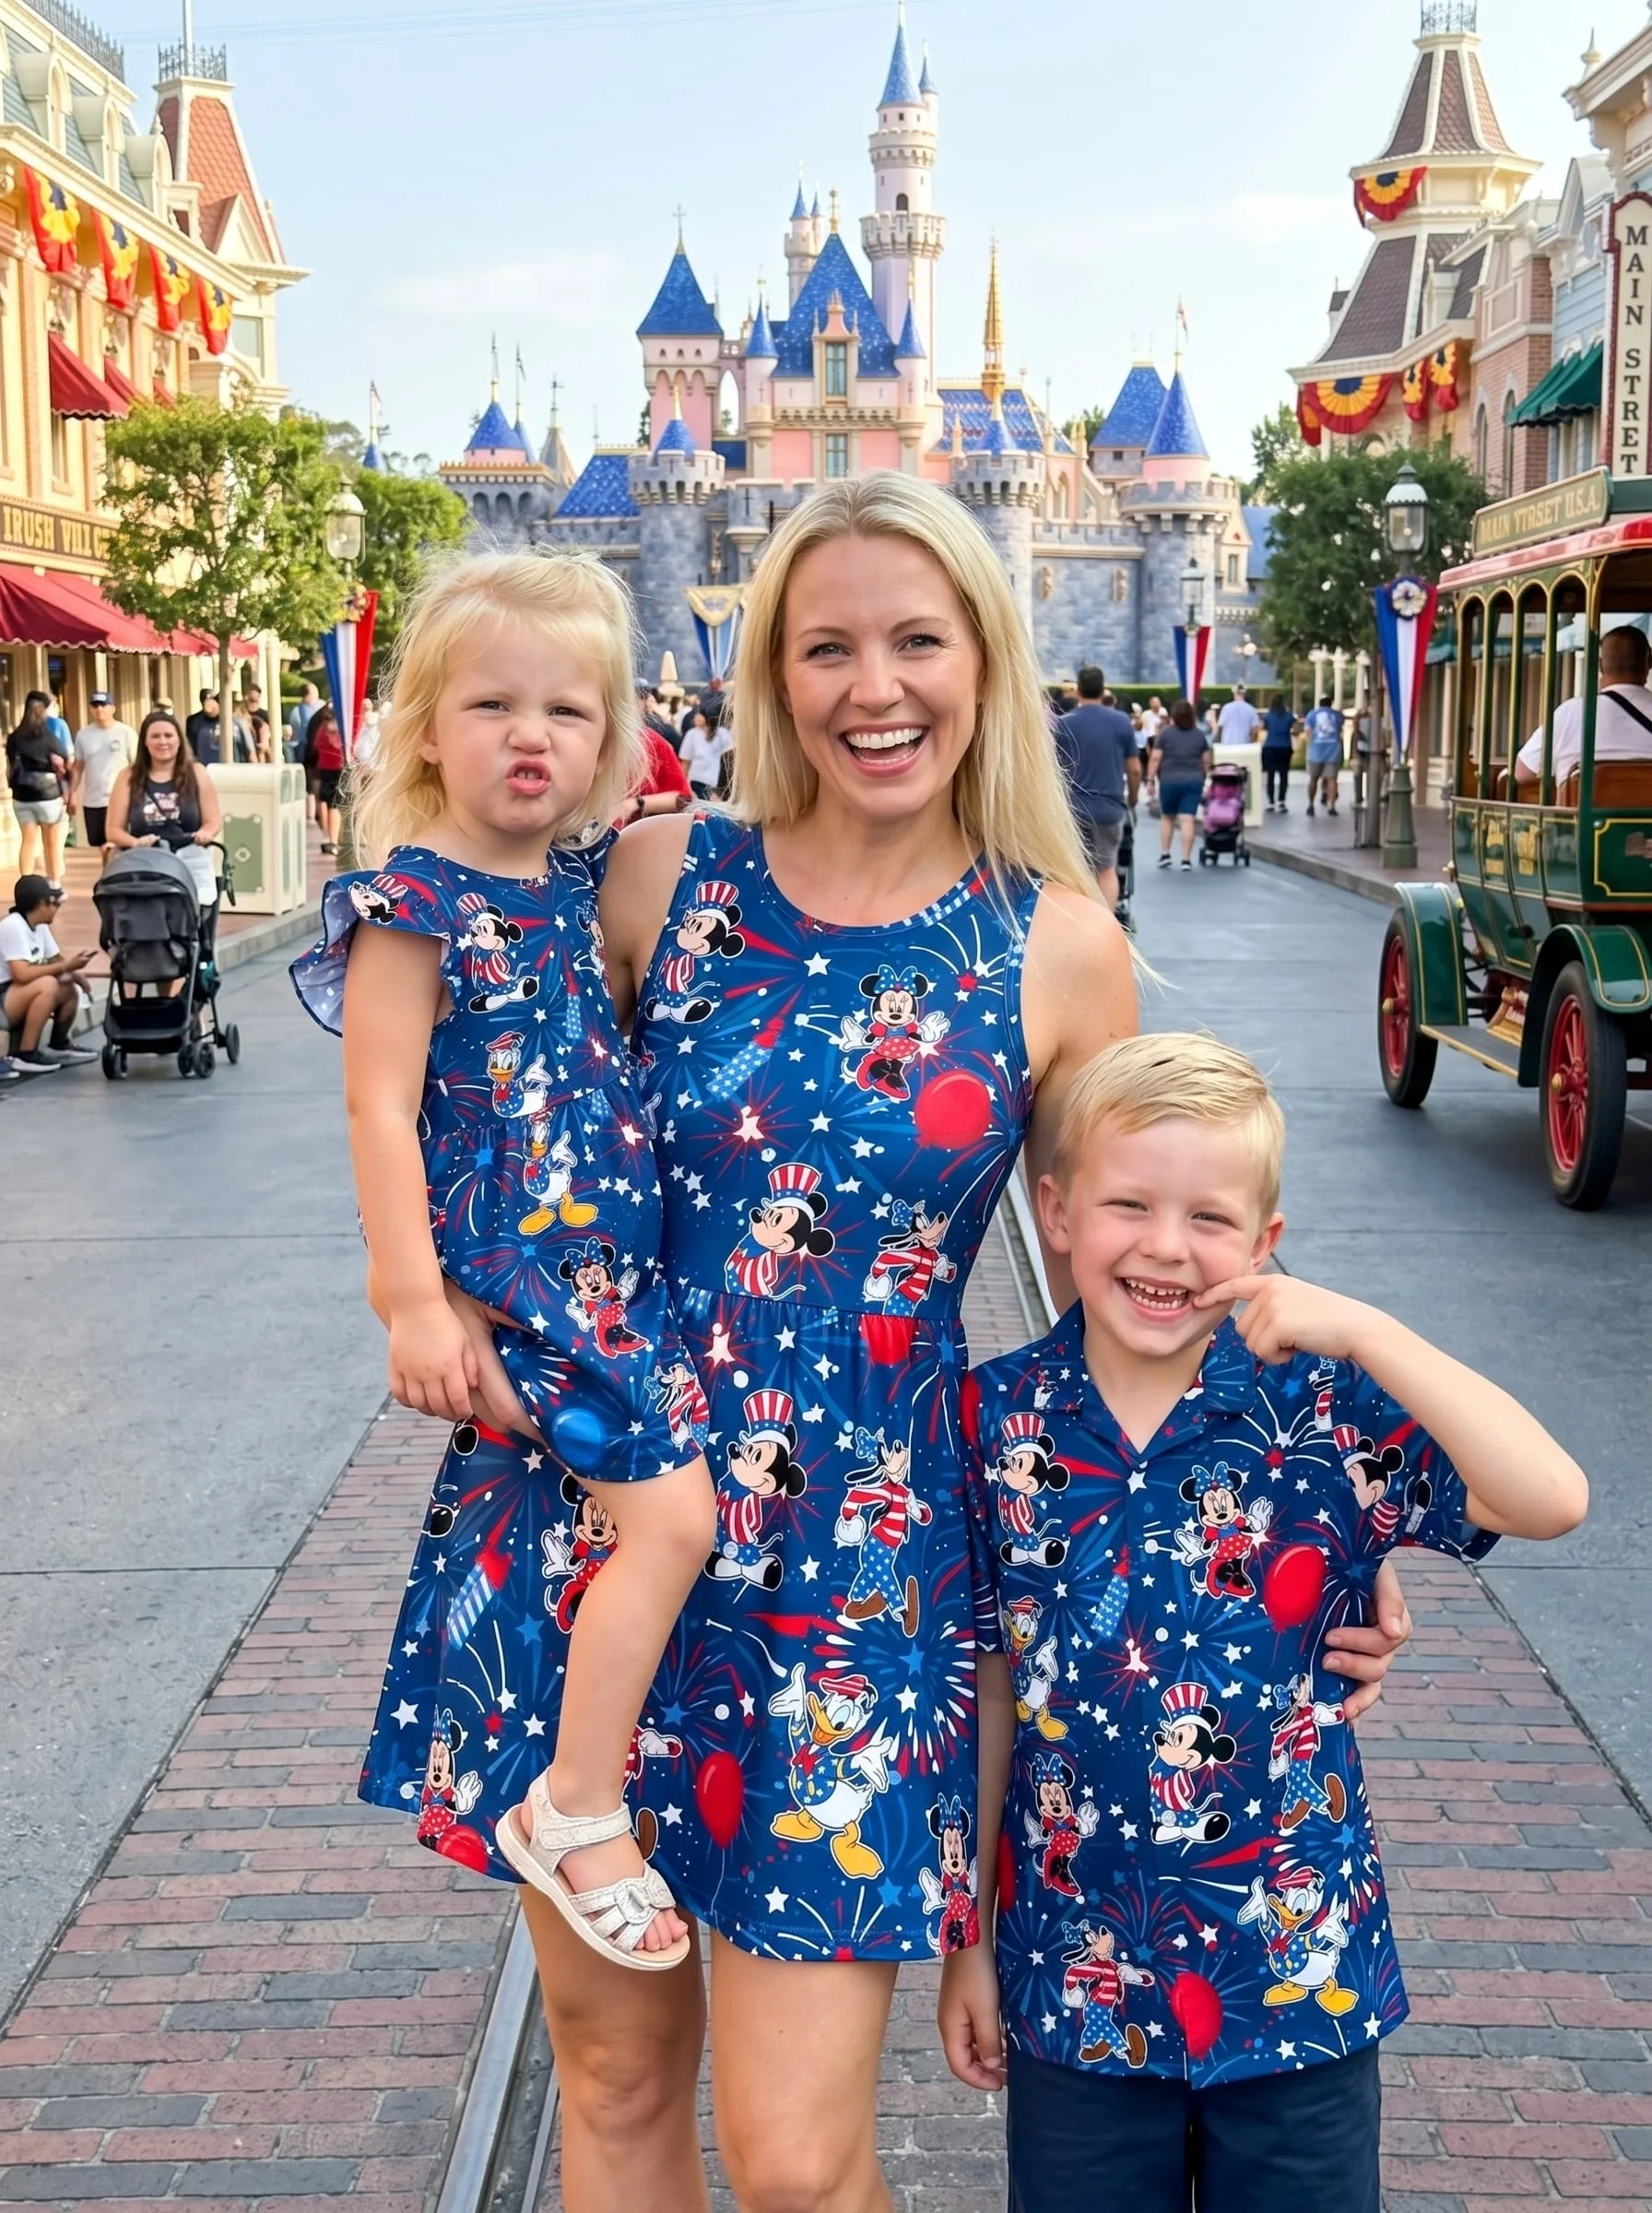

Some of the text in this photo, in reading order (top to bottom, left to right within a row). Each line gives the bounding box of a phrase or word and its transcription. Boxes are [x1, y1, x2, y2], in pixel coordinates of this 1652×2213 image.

[1621, 225, 1648, 474] MAIN STRET
[3, 504, 55, 551] IRUSH
